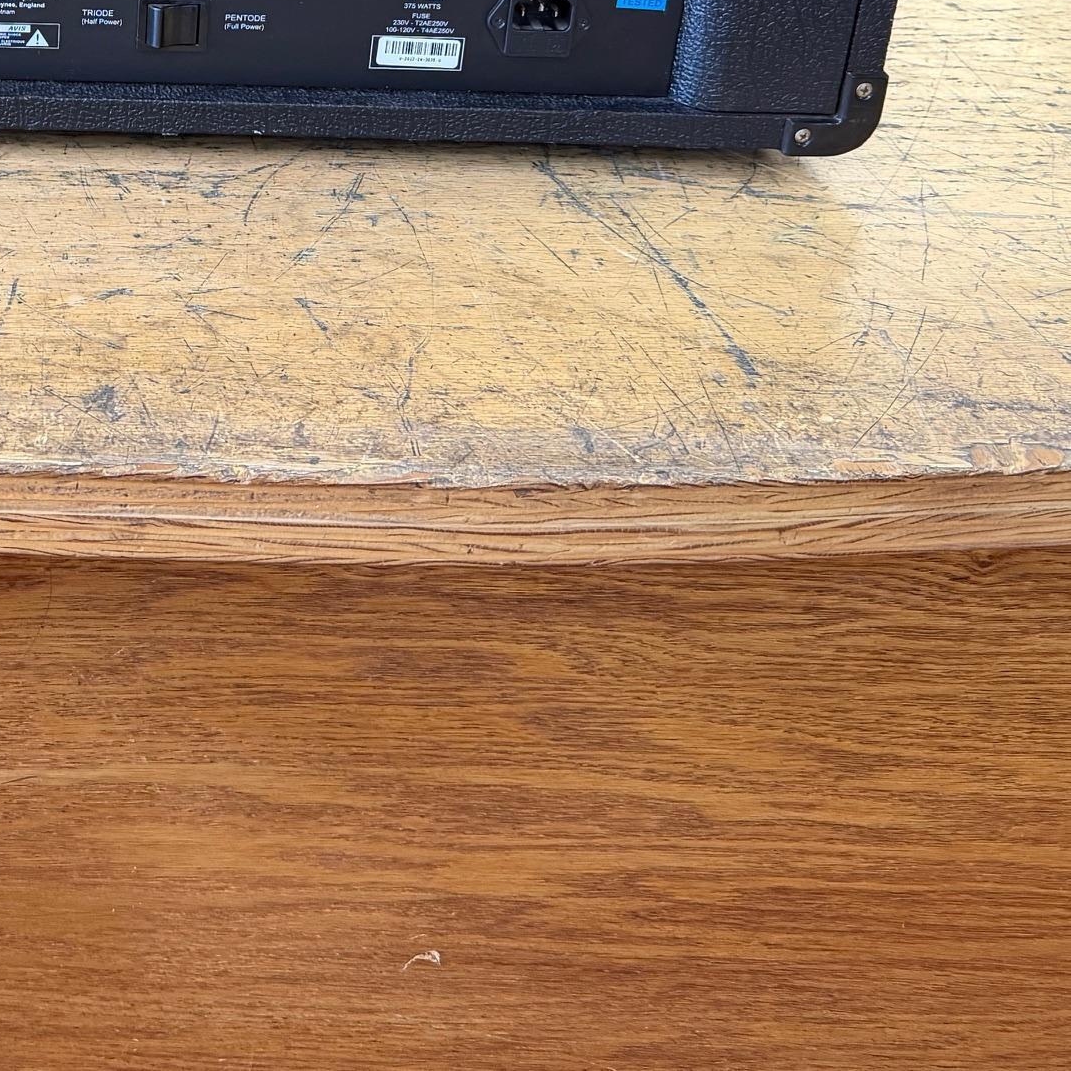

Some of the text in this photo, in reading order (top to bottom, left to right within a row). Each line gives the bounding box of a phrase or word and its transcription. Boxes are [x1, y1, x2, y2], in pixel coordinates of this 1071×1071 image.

[19, 2, 46, 10] England
[82, 9, 114, 17] TRIODE
[81, 18, 123, 27] (Half Power)
[225, 14, 266, 23] PENTODE
[241, 23, 265, 32] Power)
